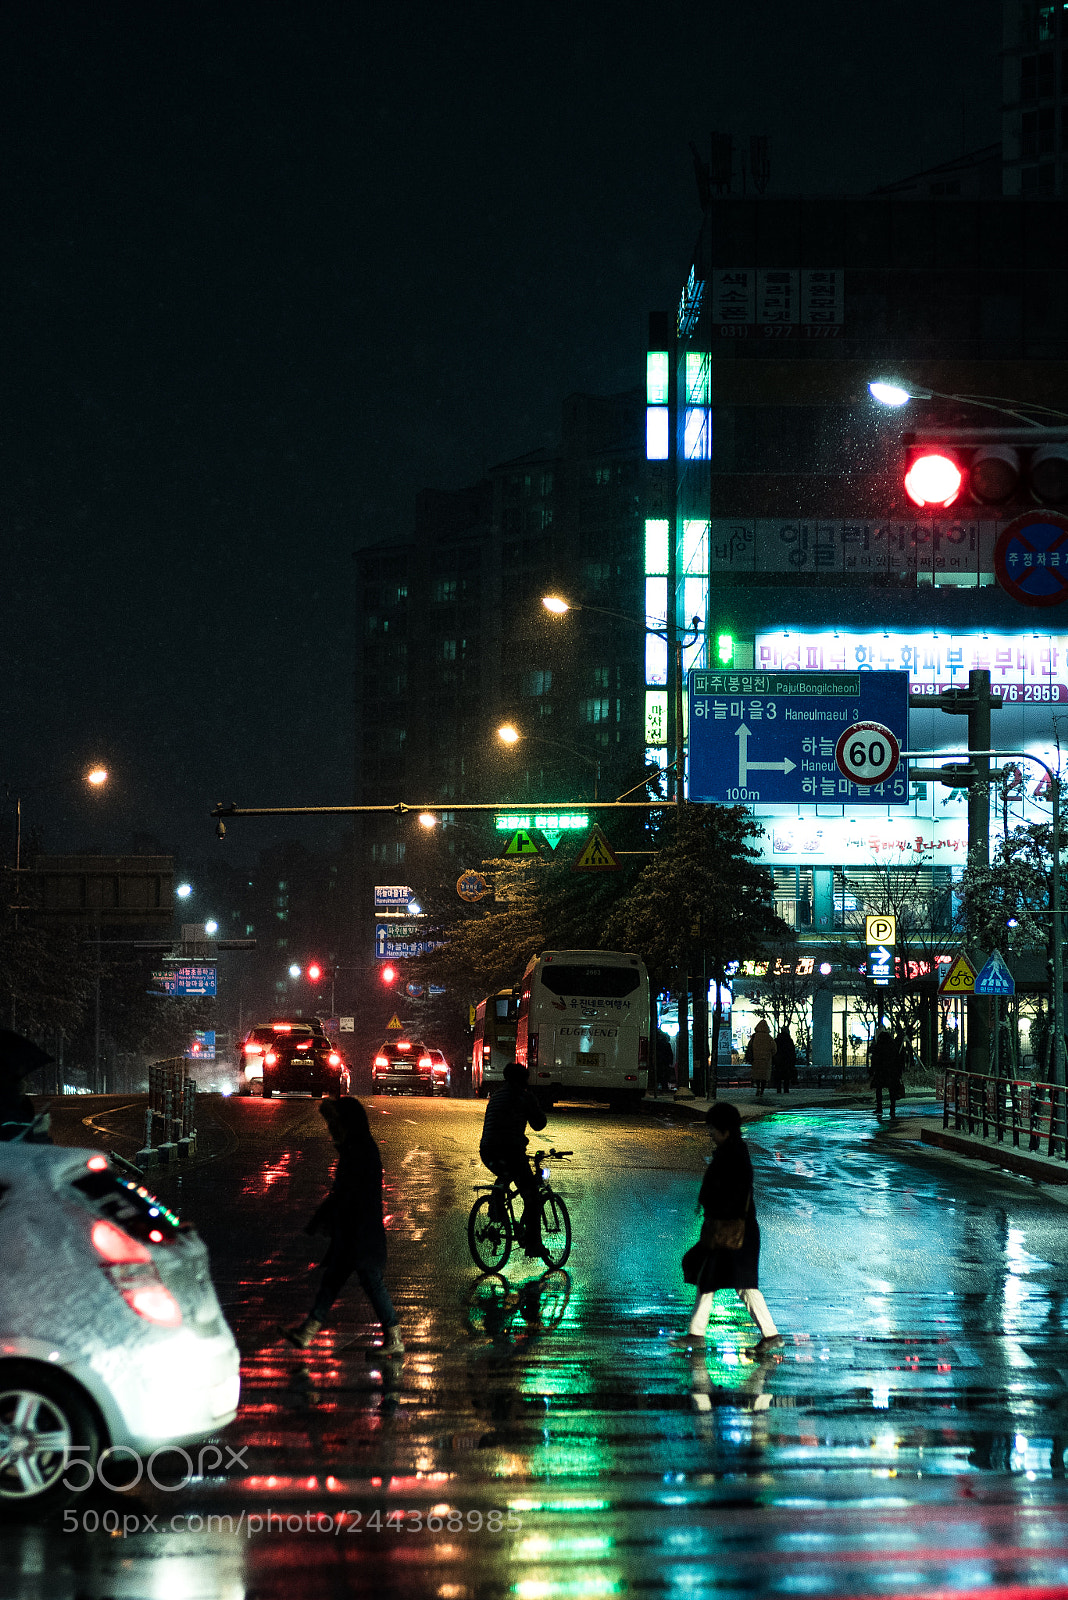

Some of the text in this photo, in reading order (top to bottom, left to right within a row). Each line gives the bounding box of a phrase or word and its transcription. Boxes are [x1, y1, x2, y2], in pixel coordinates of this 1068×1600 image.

[720, 272, 748, 321] 색소폰
[764, 325, 793, 338] 977
[804, 325, 840, 338] 1777
[1008, 553, 1068, 567] 주정차금
[696, 676, 858, 694] 파주(봉일천) Paju(Bongilcheon)
[694, 700, 777, 720] 하늘마을3
[785, 709, 859, 721] Haneulmaeul 3
[849, 741, 885, 767] 60
[725, 788, 760, 800] 100m
[876, 924, 887, 938] P
